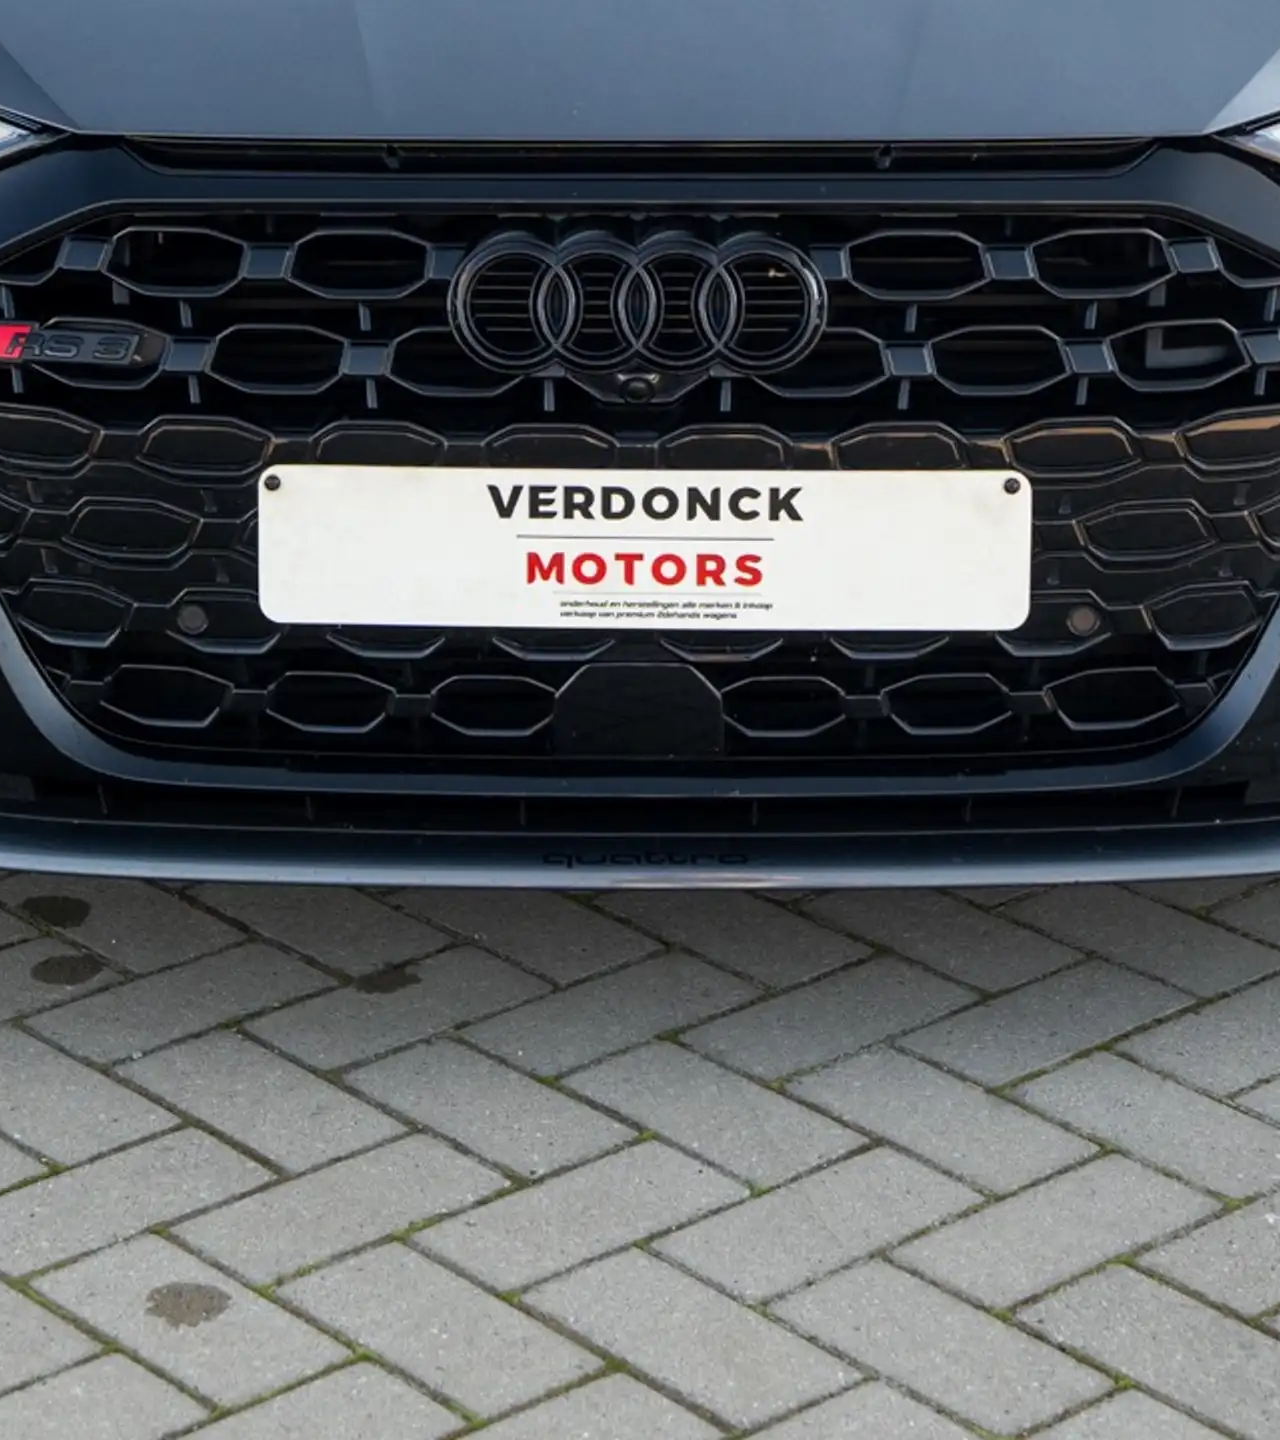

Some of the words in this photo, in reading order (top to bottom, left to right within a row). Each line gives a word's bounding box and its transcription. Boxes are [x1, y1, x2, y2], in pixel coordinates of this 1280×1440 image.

[488, 485, 802, 520] VERDONCK
[527, 552, 762, 587] MOTORS
[542, 850, 749, 869] quattro
